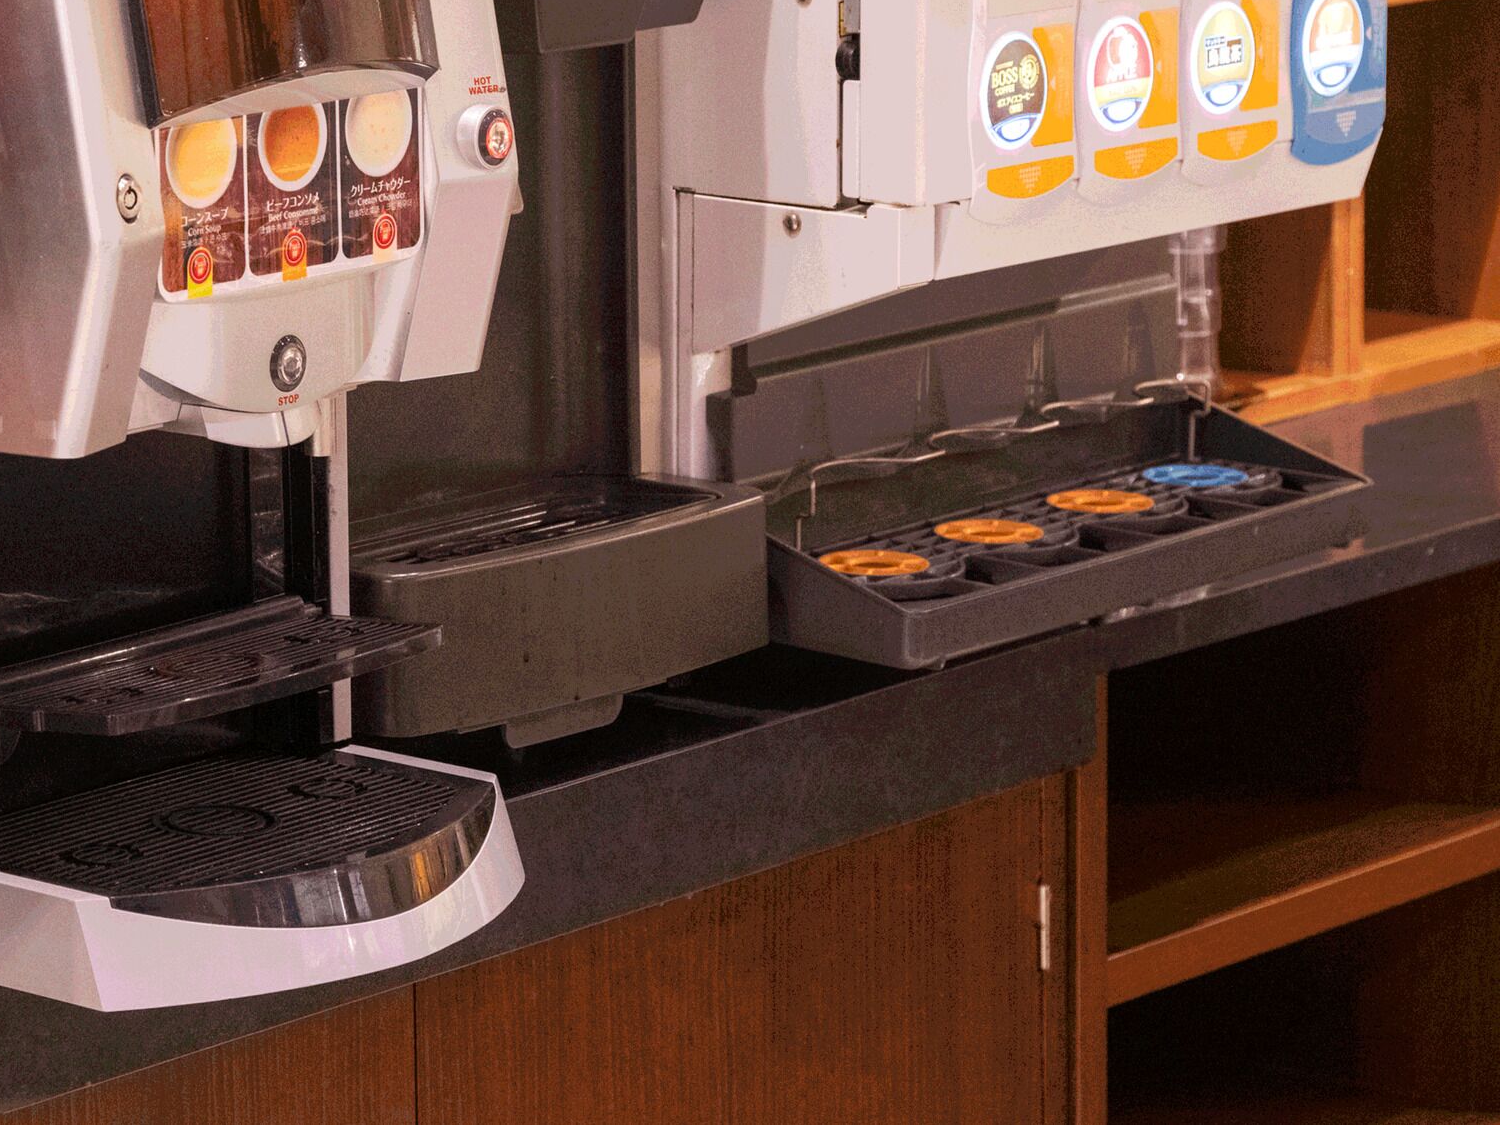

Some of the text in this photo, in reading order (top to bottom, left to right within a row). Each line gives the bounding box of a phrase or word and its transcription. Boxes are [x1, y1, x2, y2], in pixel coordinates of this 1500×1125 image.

[473, 76, 492, 86] HOT
[991, 67, 1018, 88] BOSS
[468, 84, 499, 95] WATER
[351, 176, 411, 197] クリームチャウダー
[266, 191, 320, 211] ビーフコンソメ
[357, 191, 406, 206] Cream Chowder
[181, 207, 229, 226] コーンスープ
[268, 211, 283, 222] Beef
[188, 225, 221, 237] Corn Soup
[278, 393, 300, 406] STOP
